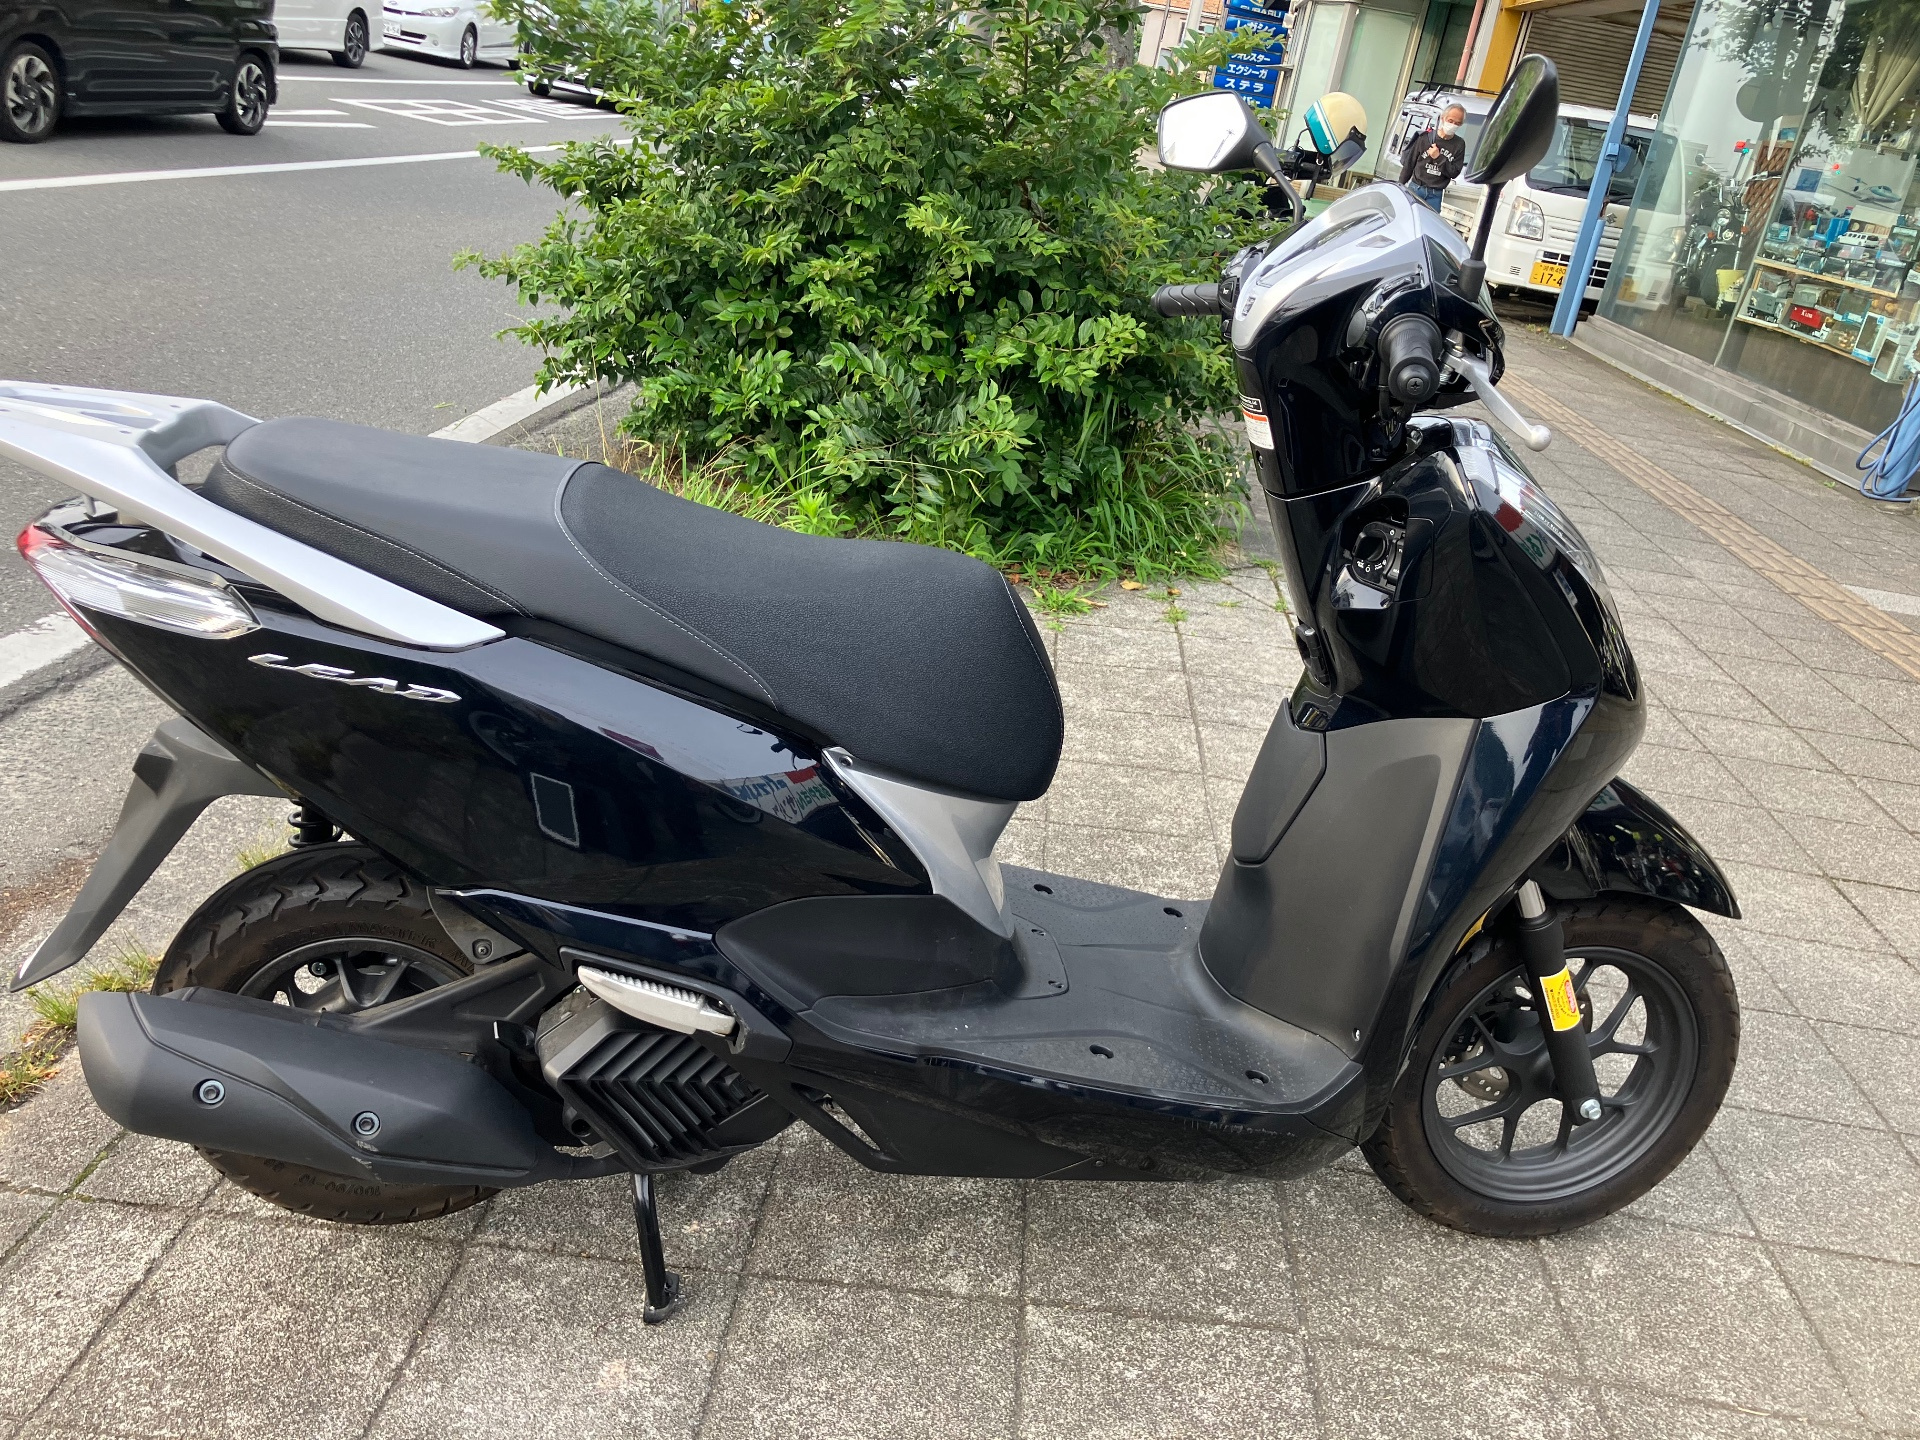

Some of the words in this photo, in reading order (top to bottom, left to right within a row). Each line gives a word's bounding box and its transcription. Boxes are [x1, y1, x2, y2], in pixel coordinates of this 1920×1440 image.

[1227, 64, 1268, 79] エクシーガ
[1225, 78, 1264, 92] ステラ
[1440, 148, 1455, 162] COAS
[1540, 272, 1564, 287] 17-4
[247, 653, 462, 704] LEAD
